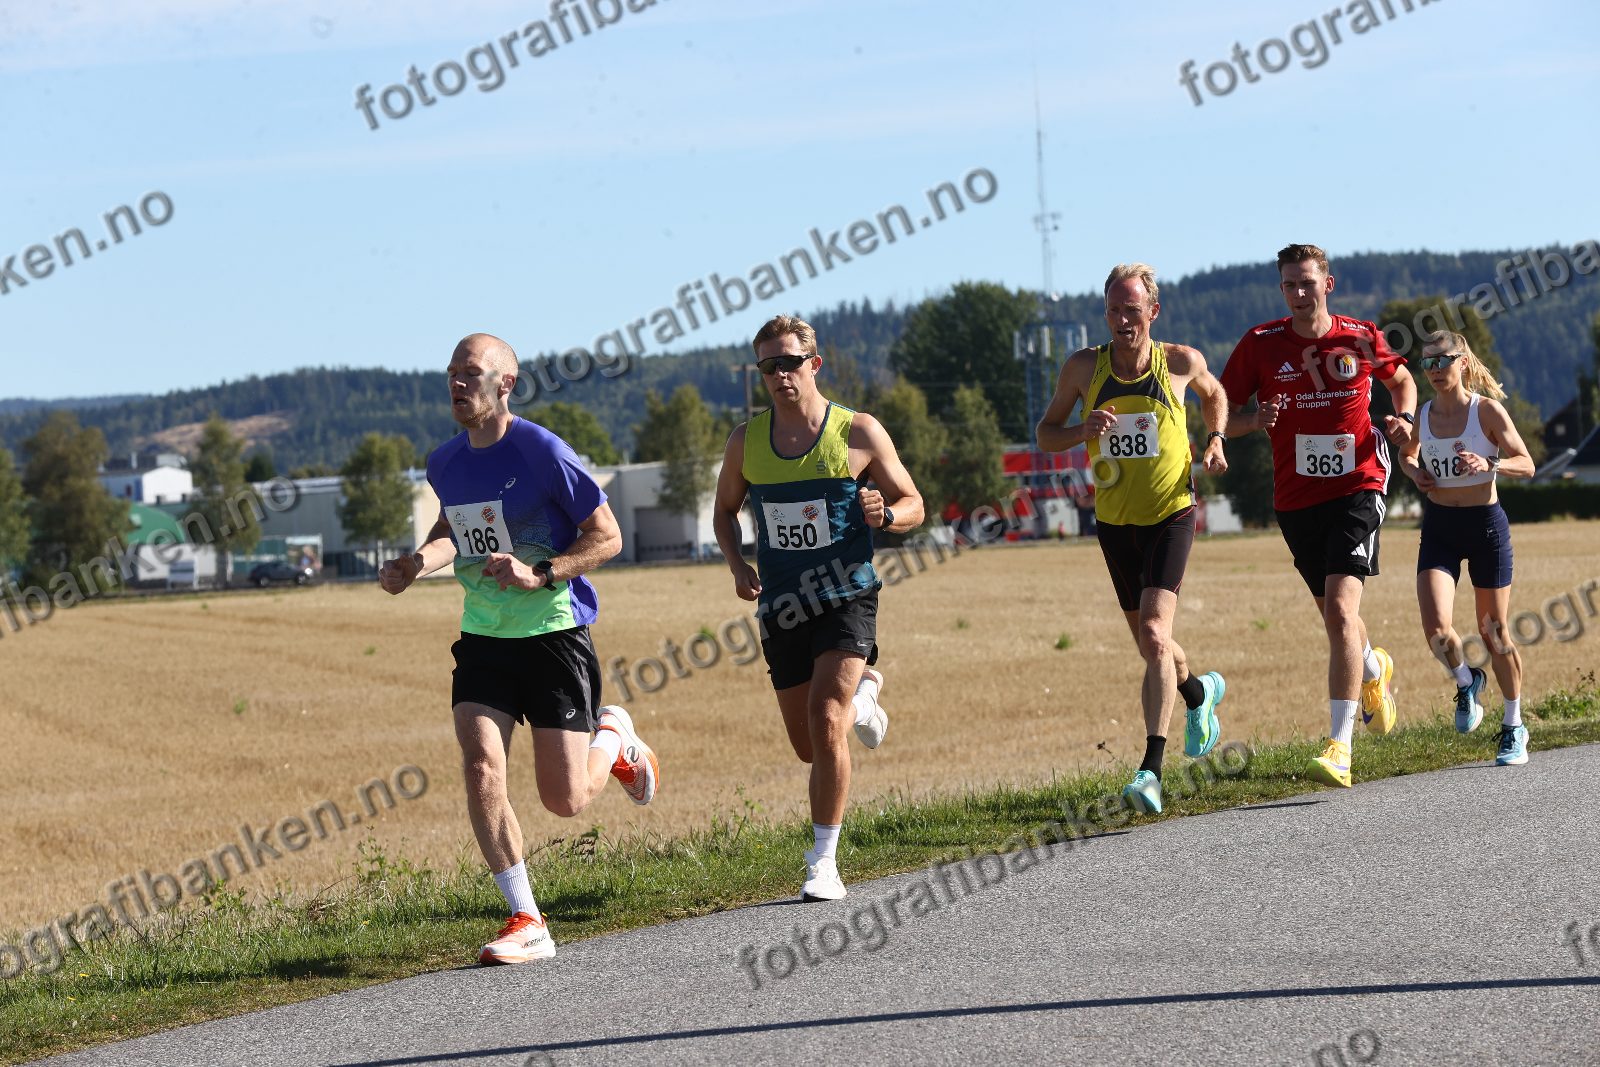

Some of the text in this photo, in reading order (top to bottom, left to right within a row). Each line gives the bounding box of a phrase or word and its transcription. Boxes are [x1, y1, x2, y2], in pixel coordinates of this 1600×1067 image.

[1295, 388, 1358, 401] Odal Sparebank
[1296, 400, 1330, 410] Gruppen
[1109, 433, 1147, 457] 838
[1306, 454, 1344, 476] 363
[463, 526, 500, 555] 186
[776, 522, 818, 549] 550
